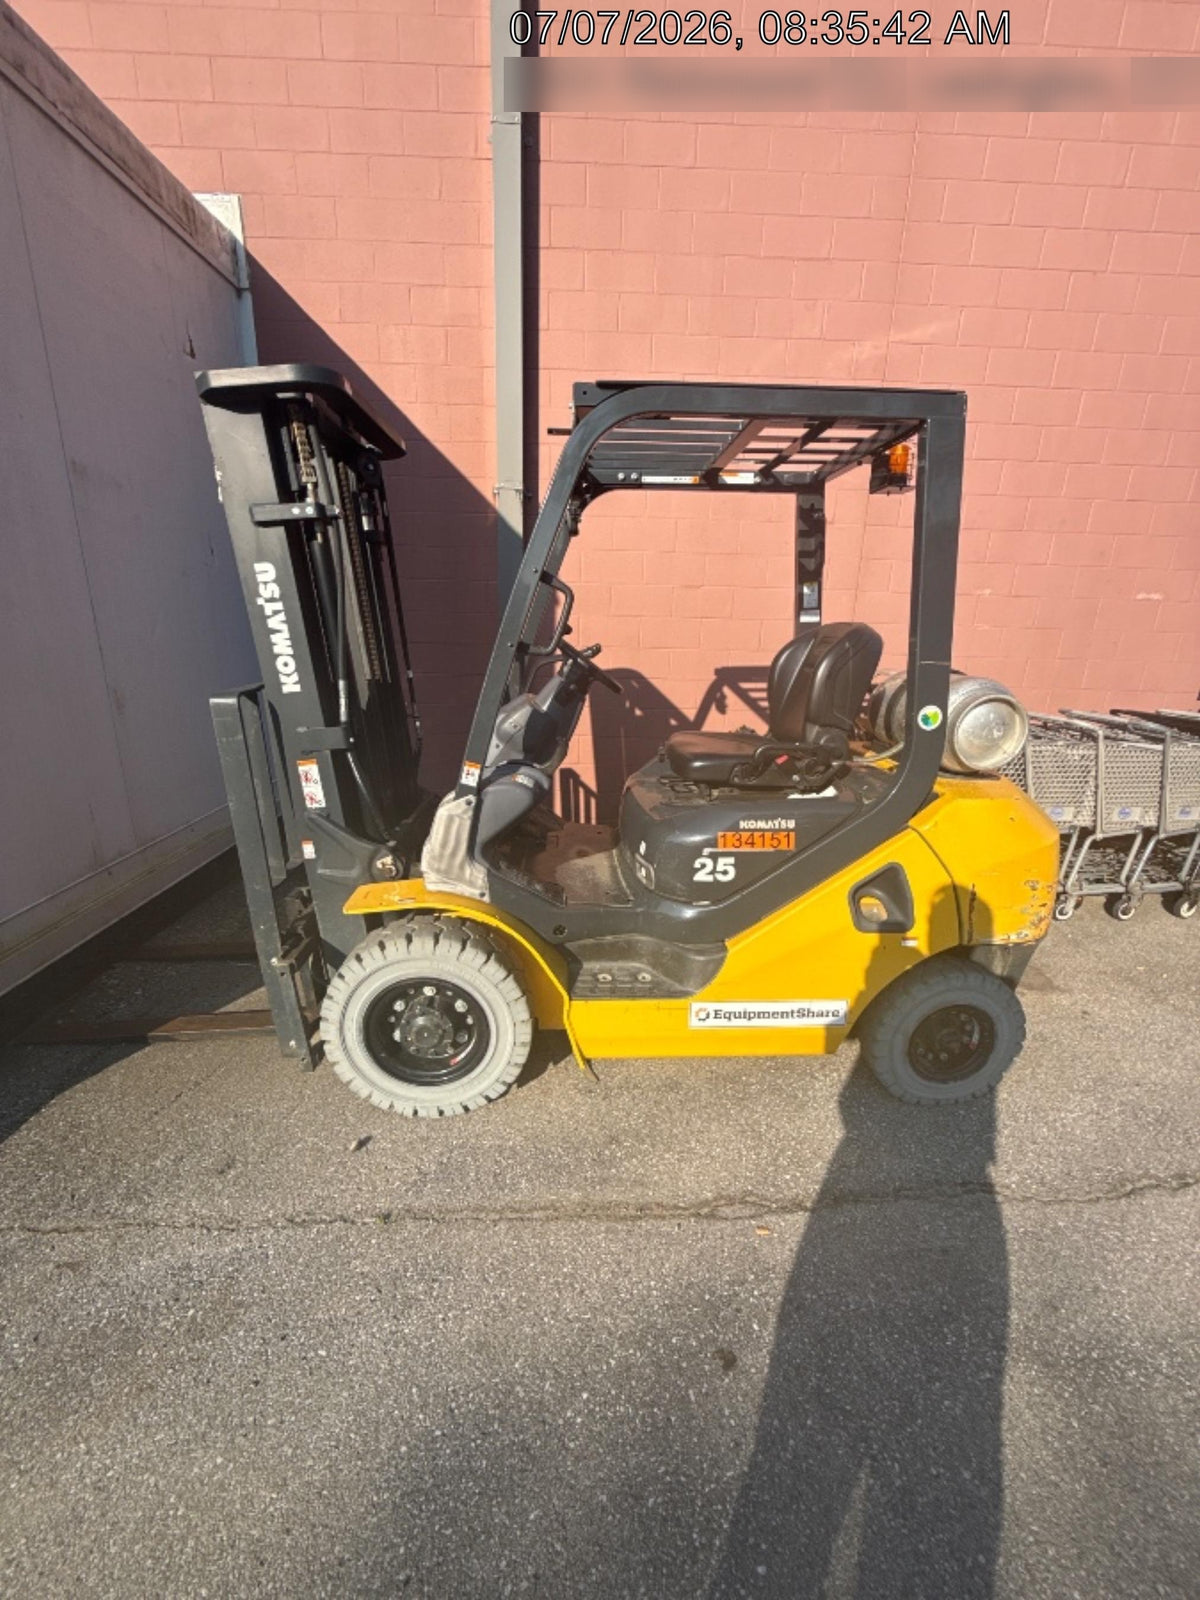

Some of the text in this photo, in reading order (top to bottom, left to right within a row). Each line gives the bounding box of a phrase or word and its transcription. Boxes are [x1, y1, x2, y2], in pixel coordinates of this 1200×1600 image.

[253, 561, 302, 693] KOMATSU
[739, 817, 796, 829] KOMATSU
[719, 832, 793, 849] 134151
[692, 857, 736, 882] 25
[712, 1007, 841, 1022] EquipmentShare
